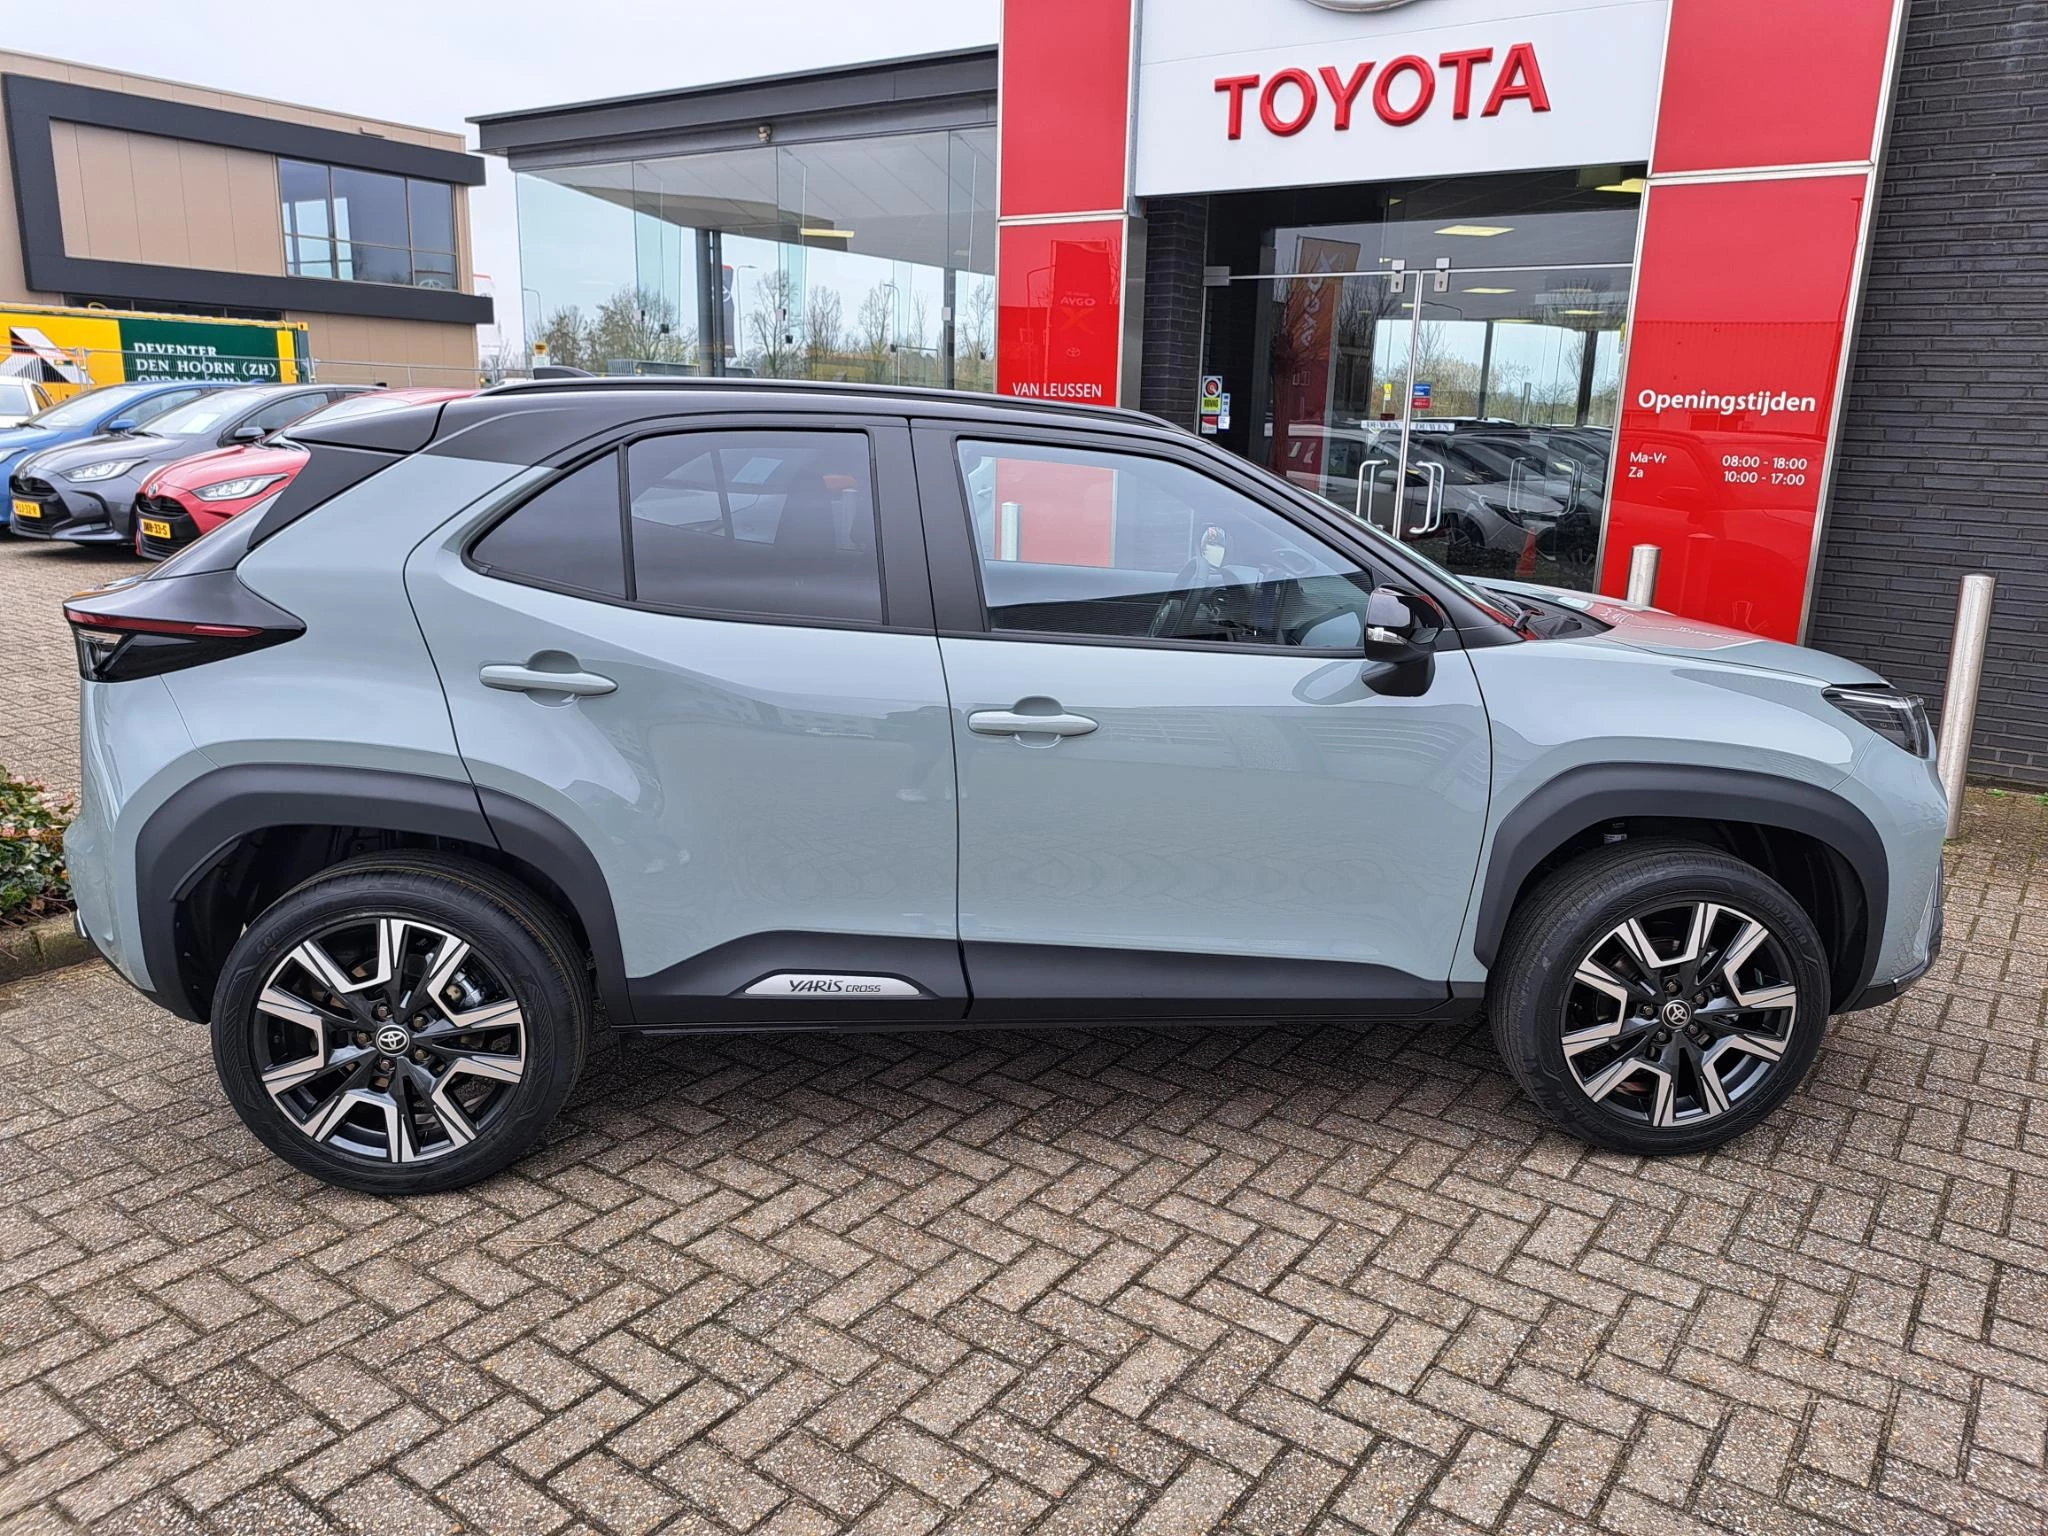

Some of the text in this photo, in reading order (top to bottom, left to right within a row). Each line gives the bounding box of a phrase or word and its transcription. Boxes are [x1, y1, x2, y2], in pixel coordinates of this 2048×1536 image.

[1214, 42, 1551, 141] TOYOTA
[1060, 296, 1097, 307] AYGO
[133, 342, 217, 356] DEVENTER
[136, 358, 276, 377] DEN HOORN (ZH)
[1012, 382, 1102, 398] VAN LEUSSEN
[1638, 388, 1816, 416] Openingstijden
[1629, 452, 1667, 464] Ma-Vr
[1722, 455, 1760, 468] 08:00
[1772, 457, 1808, 470] 18:00
[1628, 466, 1644, 478] Za
[1724, 470, 1758, 484] 10:00
[1771, 472, 1805, 486] 17:00
[846, 984, 882, 993] CROSS
